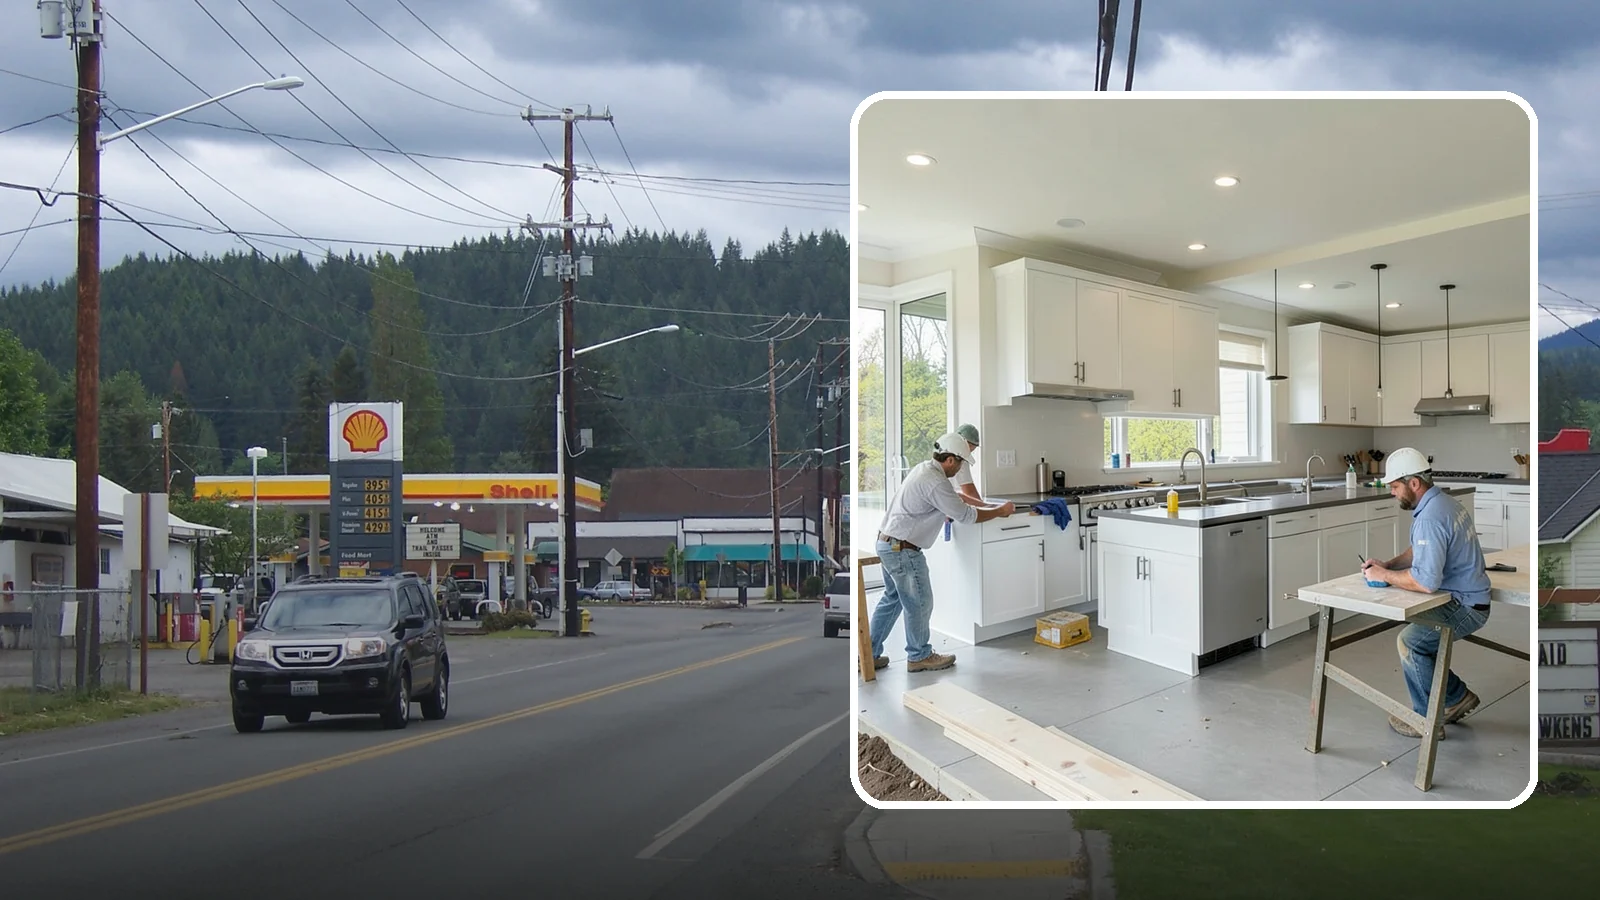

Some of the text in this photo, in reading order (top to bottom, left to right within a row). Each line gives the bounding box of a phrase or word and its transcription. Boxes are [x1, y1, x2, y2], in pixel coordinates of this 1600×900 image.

[366, 480, 383, 490] 395
[490, 484, 547, 499] Shell
[366, 494, 383, 504] 405
[366, 508, 383, 518] 415
[366, 522, 383, 532] 429
